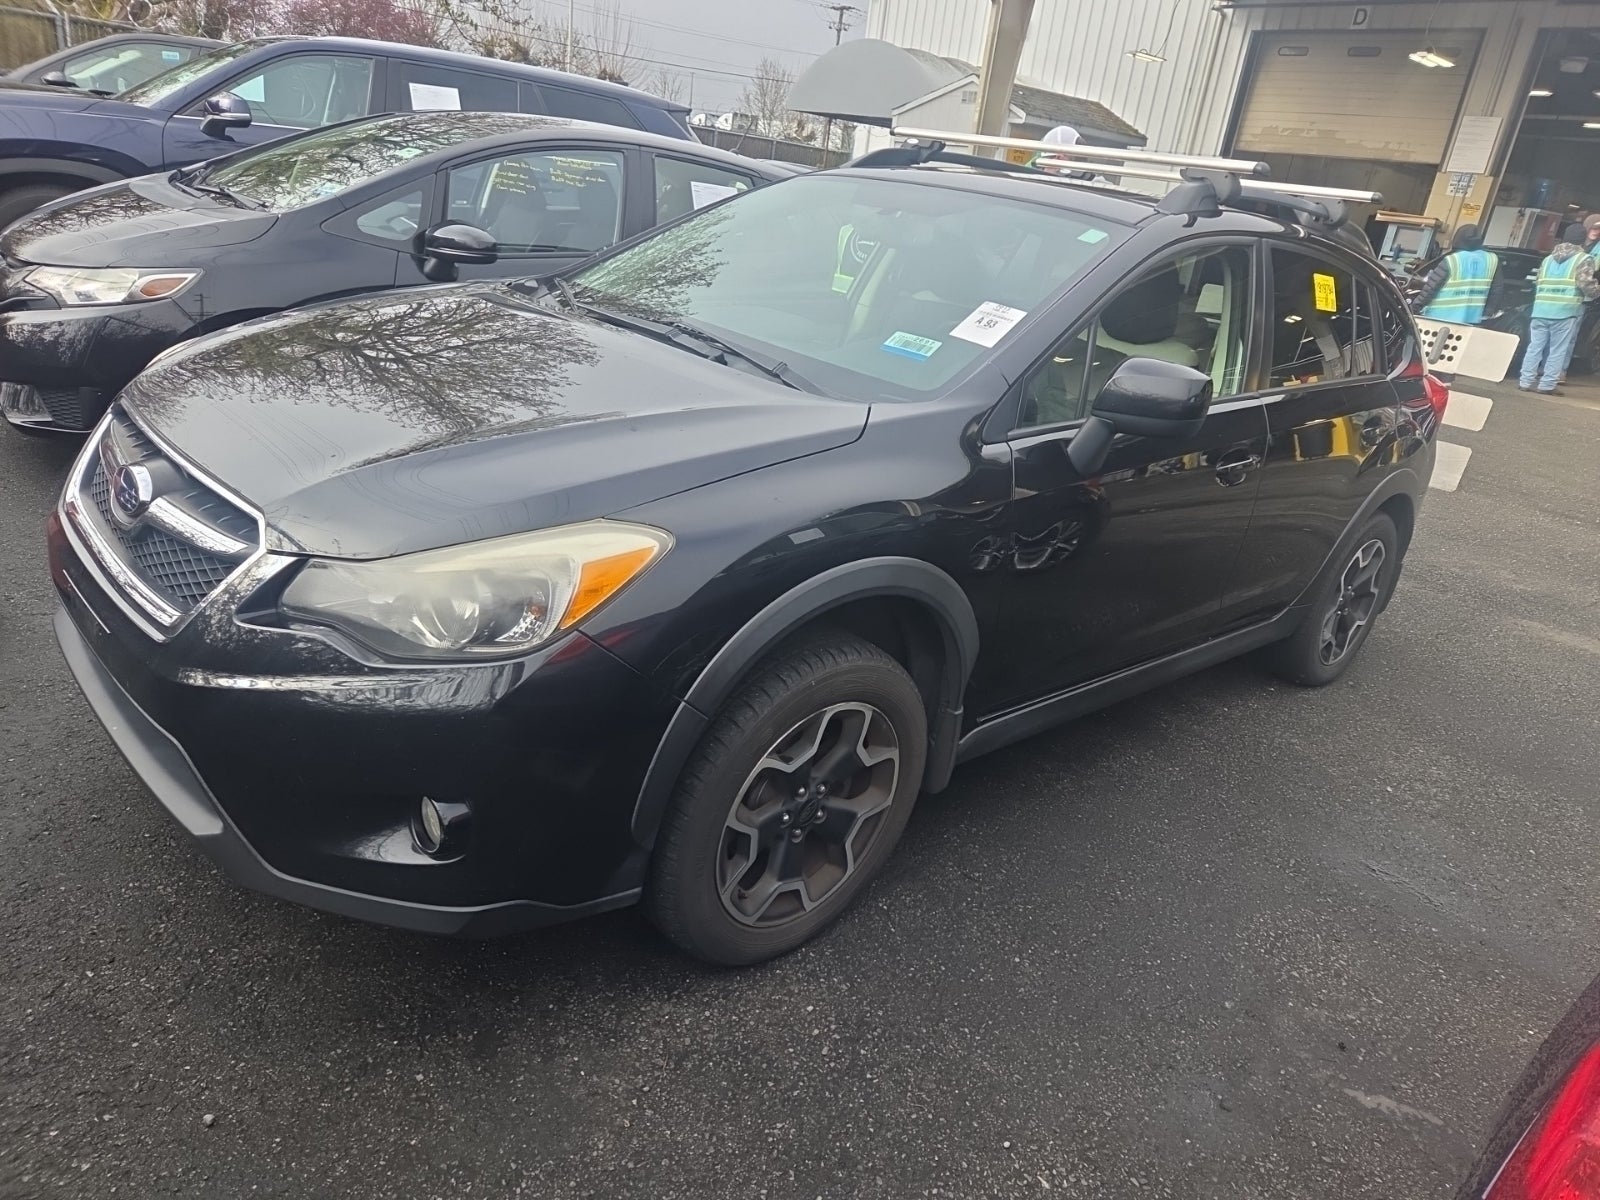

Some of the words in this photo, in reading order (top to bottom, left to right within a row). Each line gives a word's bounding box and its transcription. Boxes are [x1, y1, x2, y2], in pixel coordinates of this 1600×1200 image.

[1352, 8, 1367, 25] D
[975, 316, 985, 325] A
[984, 319, 999, 329] 93
